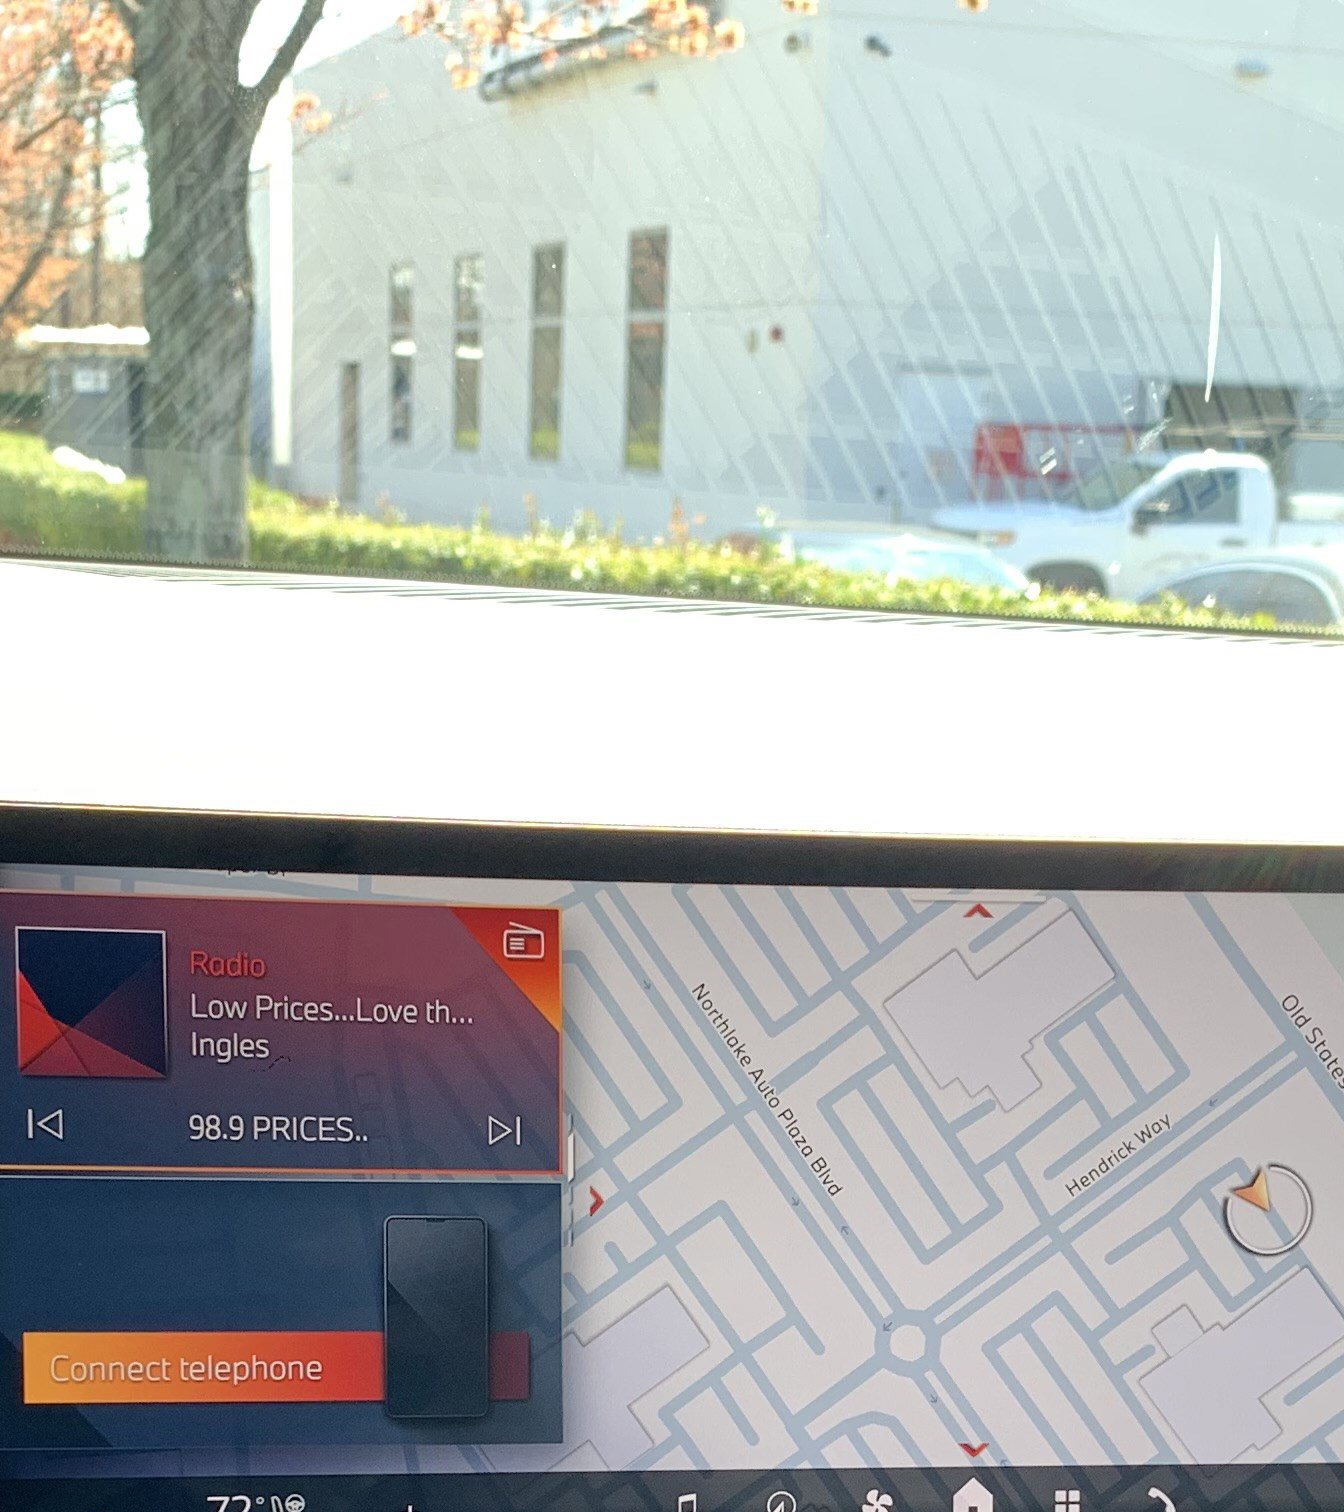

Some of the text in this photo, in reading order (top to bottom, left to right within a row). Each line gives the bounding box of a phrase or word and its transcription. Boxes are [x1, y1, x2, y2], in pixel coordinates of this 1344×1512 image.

[189, 950, 267, 978] Radio
[191, 992, 248, 1020] Low
[1281, 994, 1311, 1029] Old
[191, 1031, 270, 1064] Ingles
[691, 982, 843, 1197] Northlake Auto Plaza Blvd
[188, 1113, 368, 1142] 98.9 PRICES..
[1064, 1113, 1173, 1197] Hendrick Way
[50, 1353, 323, 1388] Connect telephone
